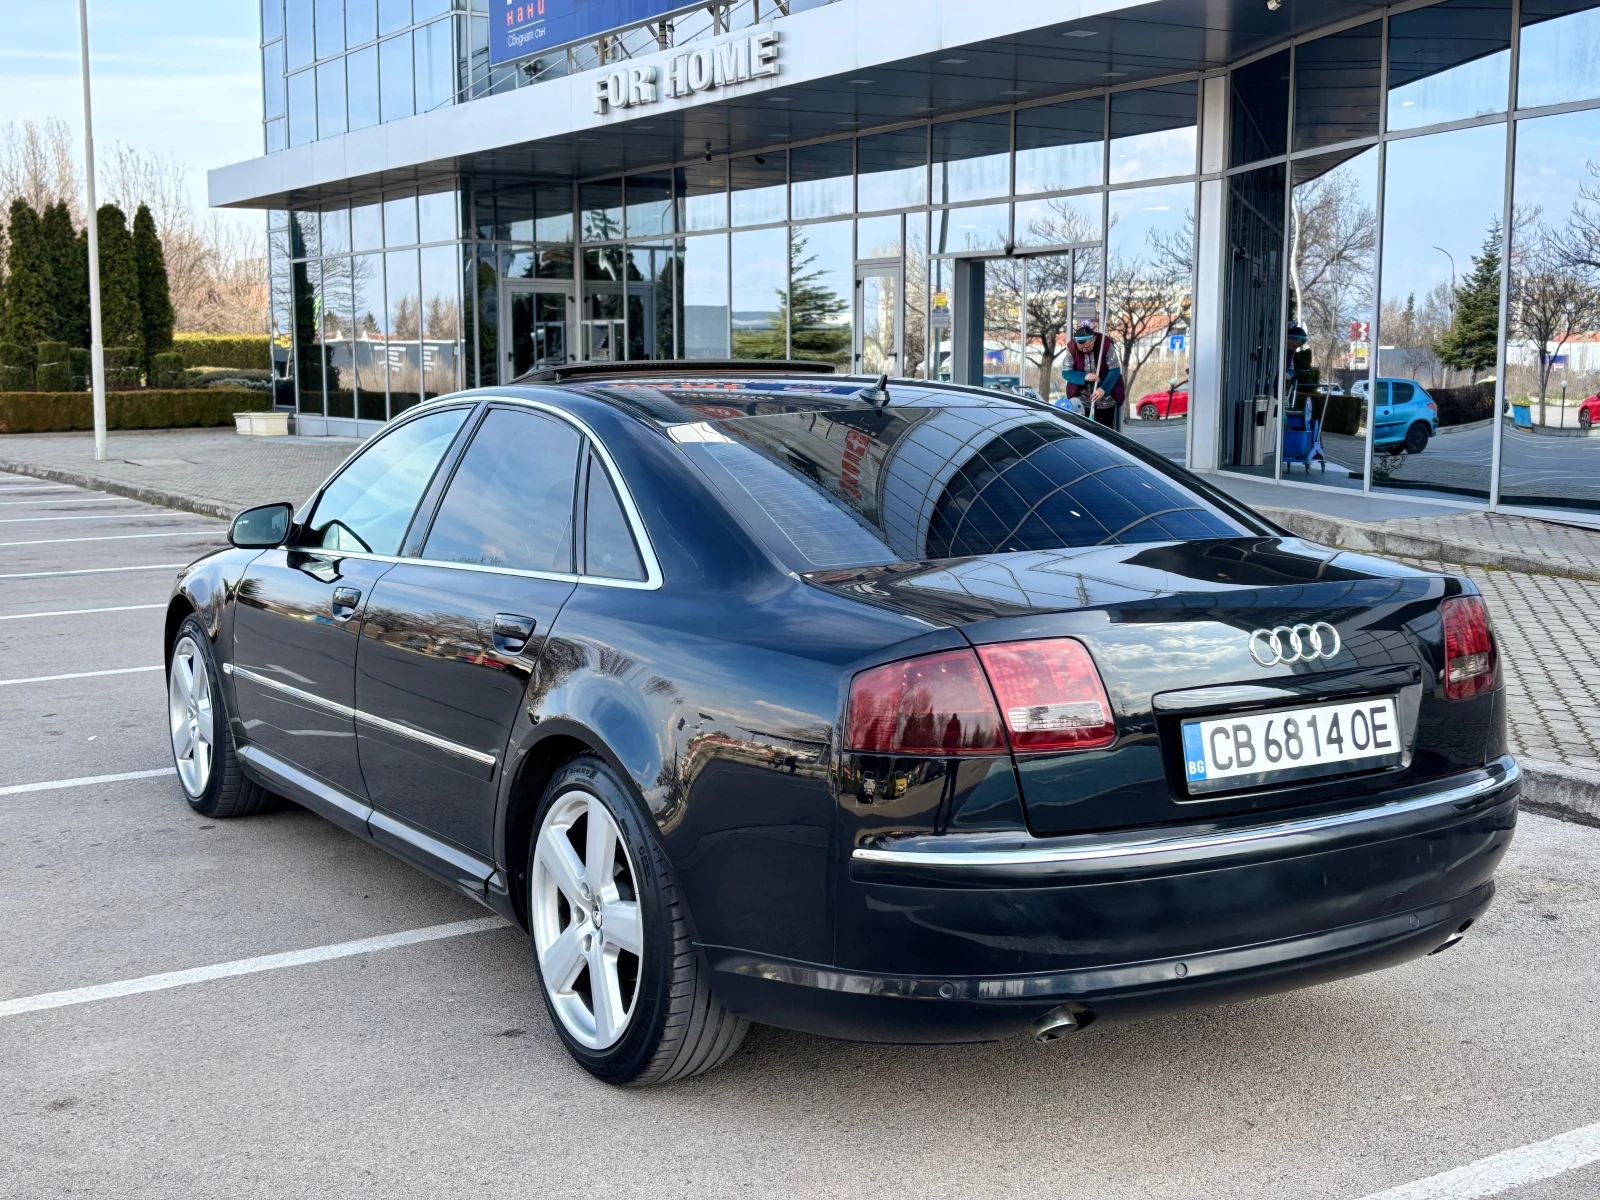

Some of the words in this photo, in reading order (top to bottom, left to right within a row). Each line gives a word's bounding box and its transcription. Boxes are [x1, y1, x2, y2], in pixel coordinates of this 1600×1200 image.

[592, 65, 658, 115] FOR
[664, 30, 781, 99] HOME
[1188, 759, 1205, 776] BG
[1209, 723, 1256, 771] CB
[1263, 711, 1344, 764] 6814
